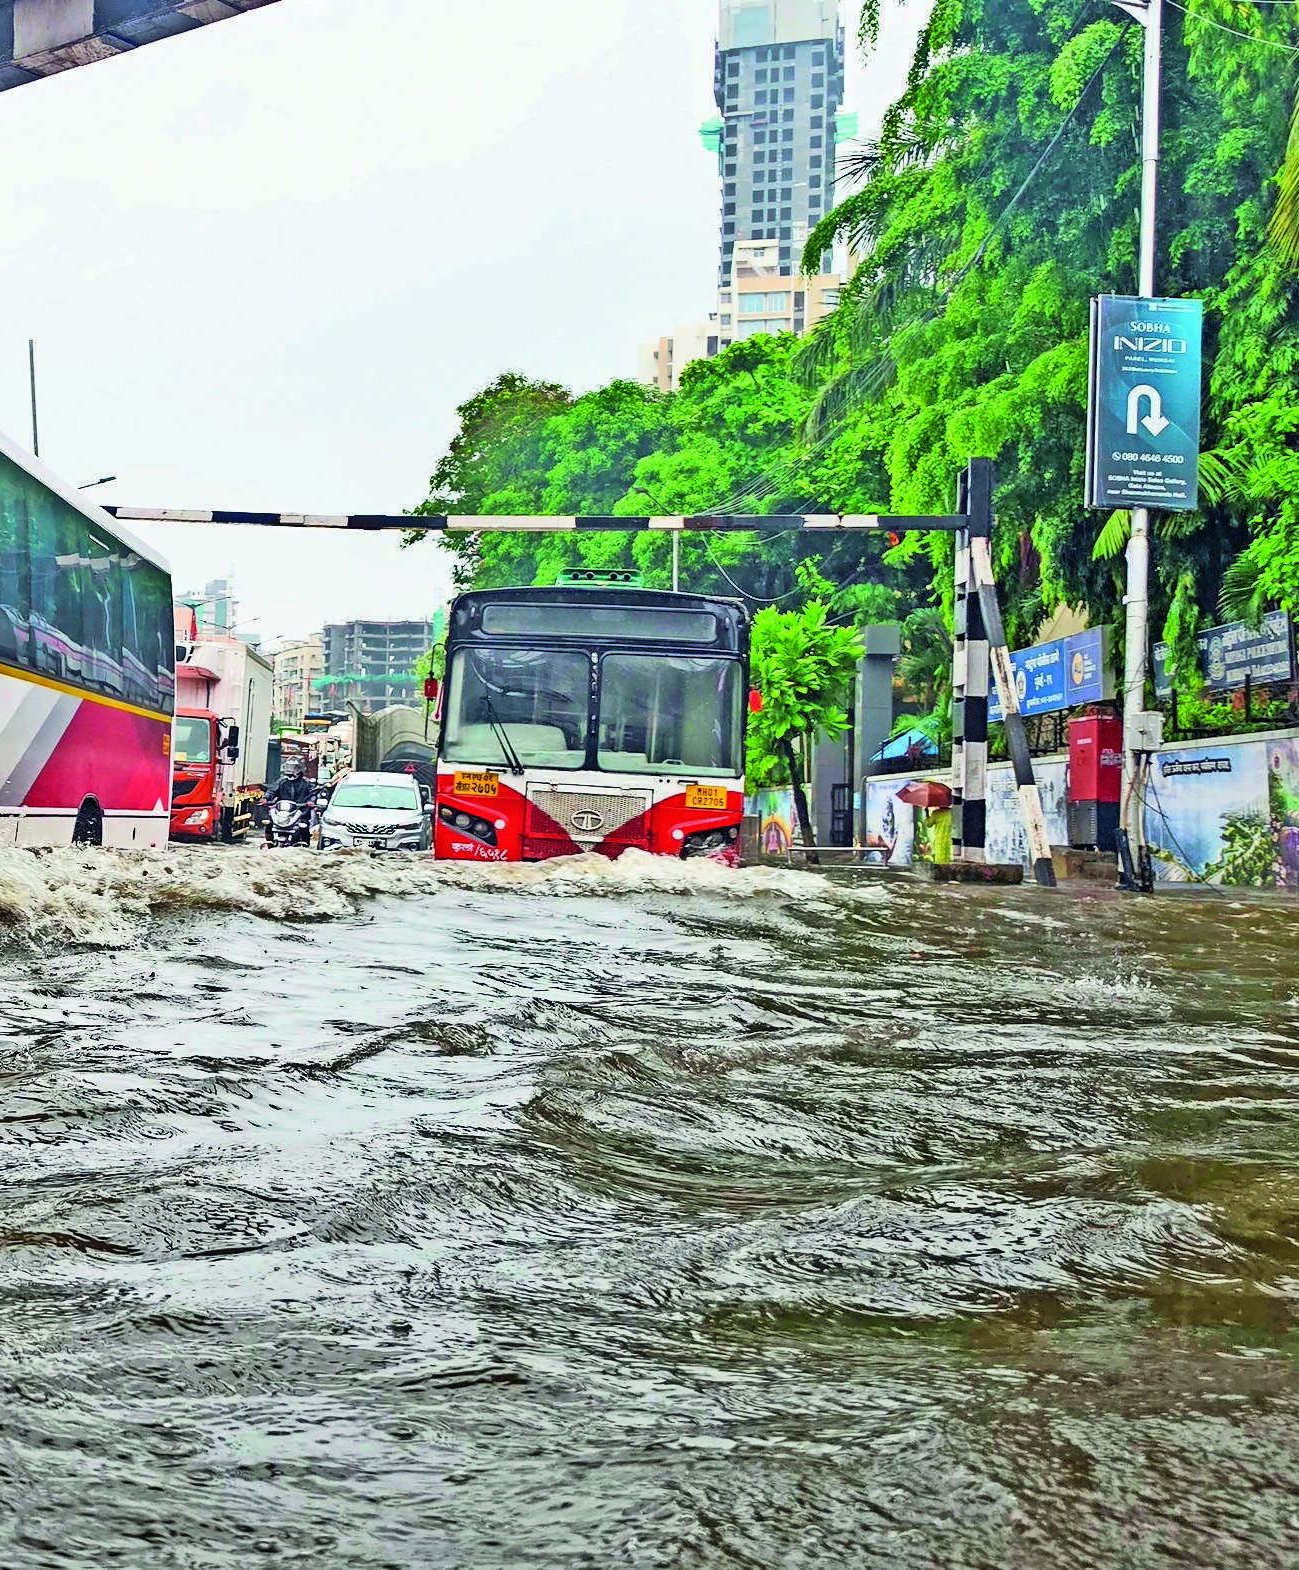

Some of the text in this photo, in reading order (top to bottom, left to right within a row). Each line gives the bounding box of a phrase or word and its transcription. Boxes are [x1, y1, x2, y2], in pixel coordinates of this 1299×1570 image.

[1129, 321, 1171, 333] SOBHA
[1113, 335, 1187, 354] INIZIO
[1121, 452, 1139, 461] 080
[1162, 454, 1184, 464] 4500
[697, 787, 718, 796] MH01
